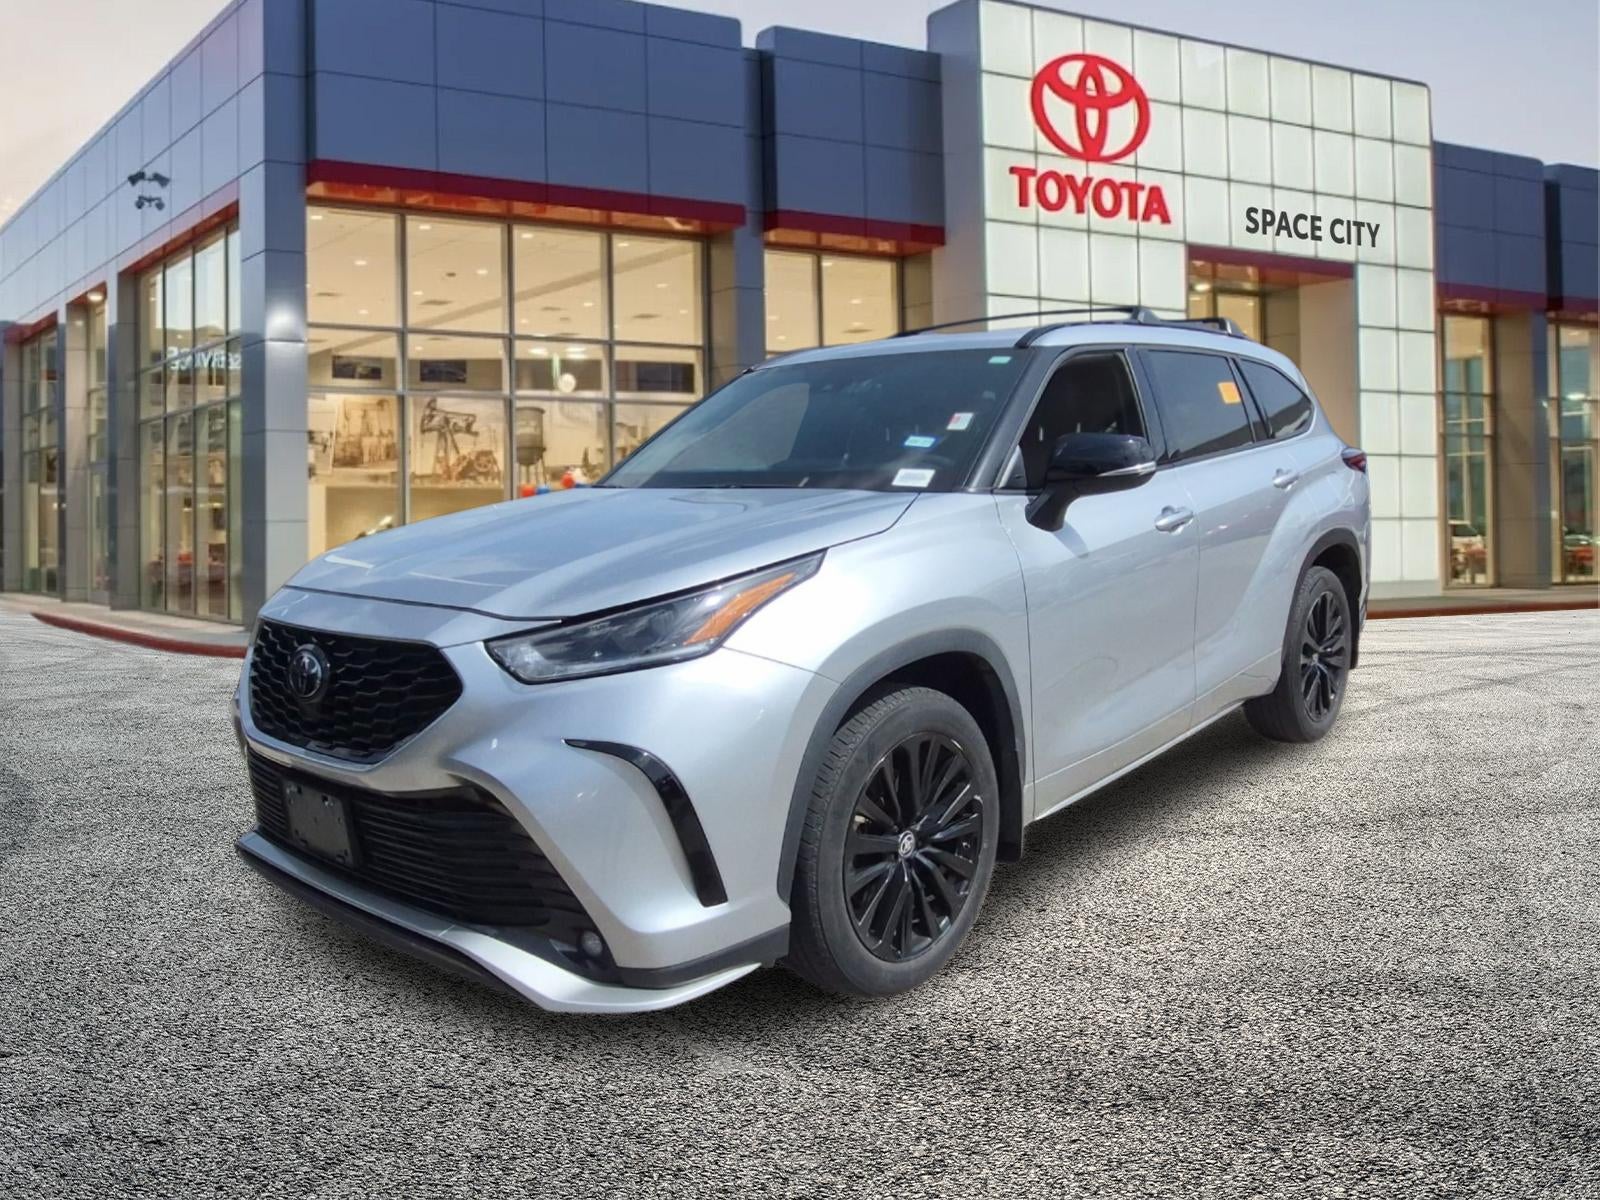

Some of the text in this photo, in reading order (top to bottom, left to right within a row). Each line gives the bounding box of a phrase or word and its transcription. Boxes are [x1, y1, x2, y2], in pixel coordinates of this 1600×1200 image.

[1009, 166, 1171, 224] TOYOTA
[1245, 206, 1381, 248] SPACE CITY
